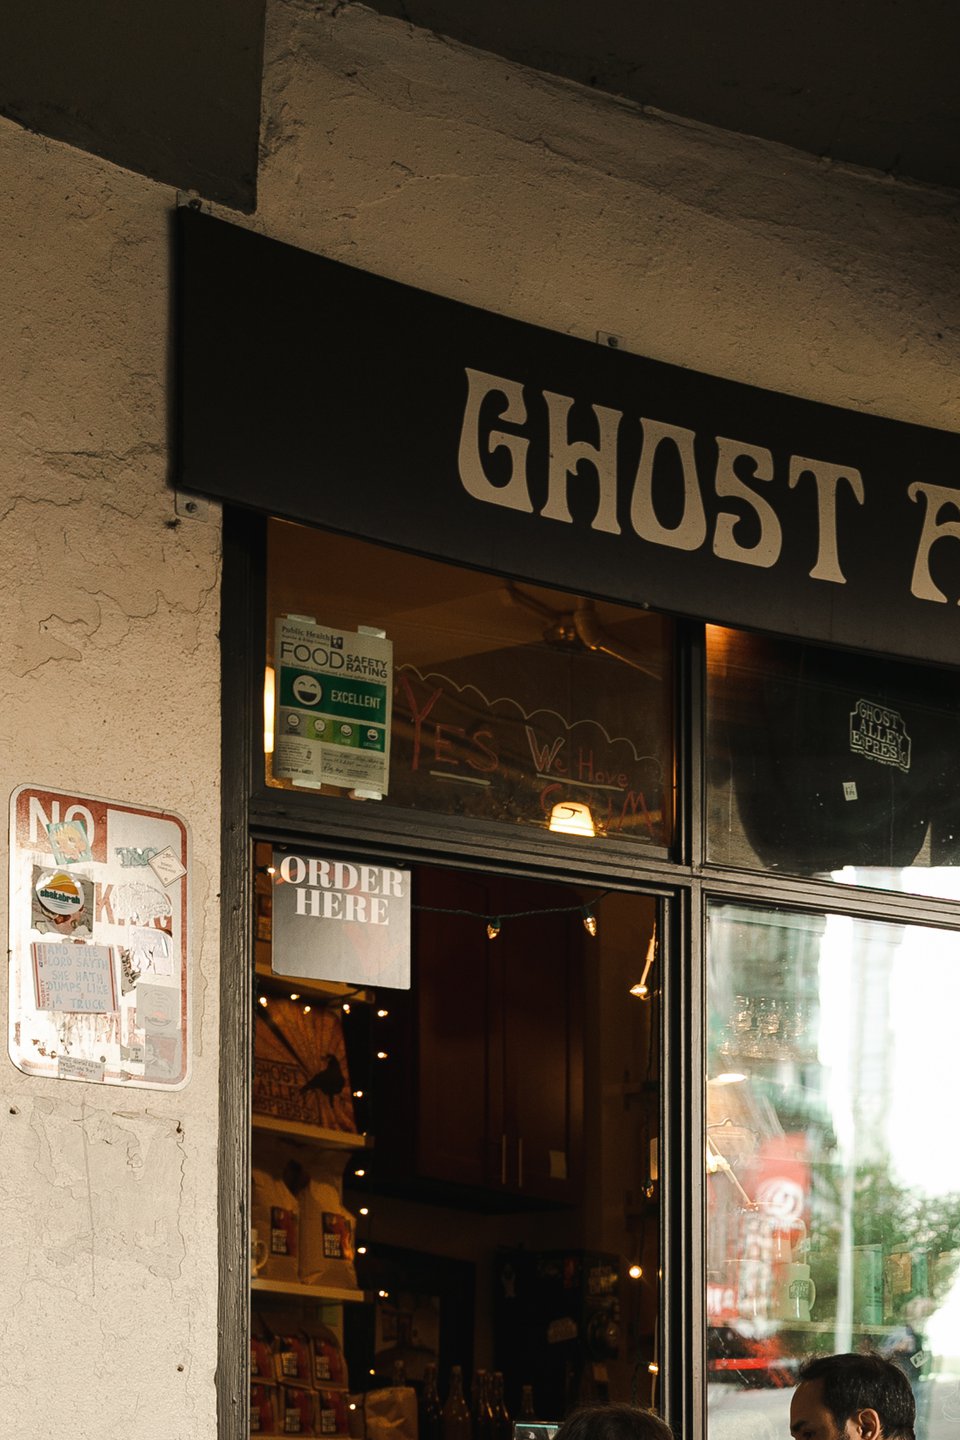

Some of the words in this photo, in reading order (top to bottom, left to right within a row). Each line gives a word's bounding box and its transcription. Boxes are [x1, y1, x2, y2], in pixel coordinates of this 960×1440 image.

[456, 366, 864, 586] GHOST
[280, 641, 345, 669] FOOD
[346, 654, 388, 669] SAFETY
[346, 663, 388, 679] RATING
[331, 689, 381, 710] EXCELLENT
[402, 675, 499, 773] YES
[858, 702, 899, 730] GHOST
[859, 718, 904, 746] ALLEY
[526, 724, 568, 774] We
[578, 747, 629, 788] Have
[29, 796, 95, 848] NO
[279, 855, 404, 898] ORDER
[39, 889, 81, 905] shakabrah
[294, 887, 391, 926] HERE
[48, 944, 69, 955] AND
[76, 946, 99, 957] THE
[48, 956, 73, 967] LORD
[48, 981, 81, 992] DUMPS
[87, 983, 109, 995] LIKE
[52, 970, 70, 981] SHE
[75, 971, 104, 985] HATH
[70, 998, 106, 1010] TRUCK
